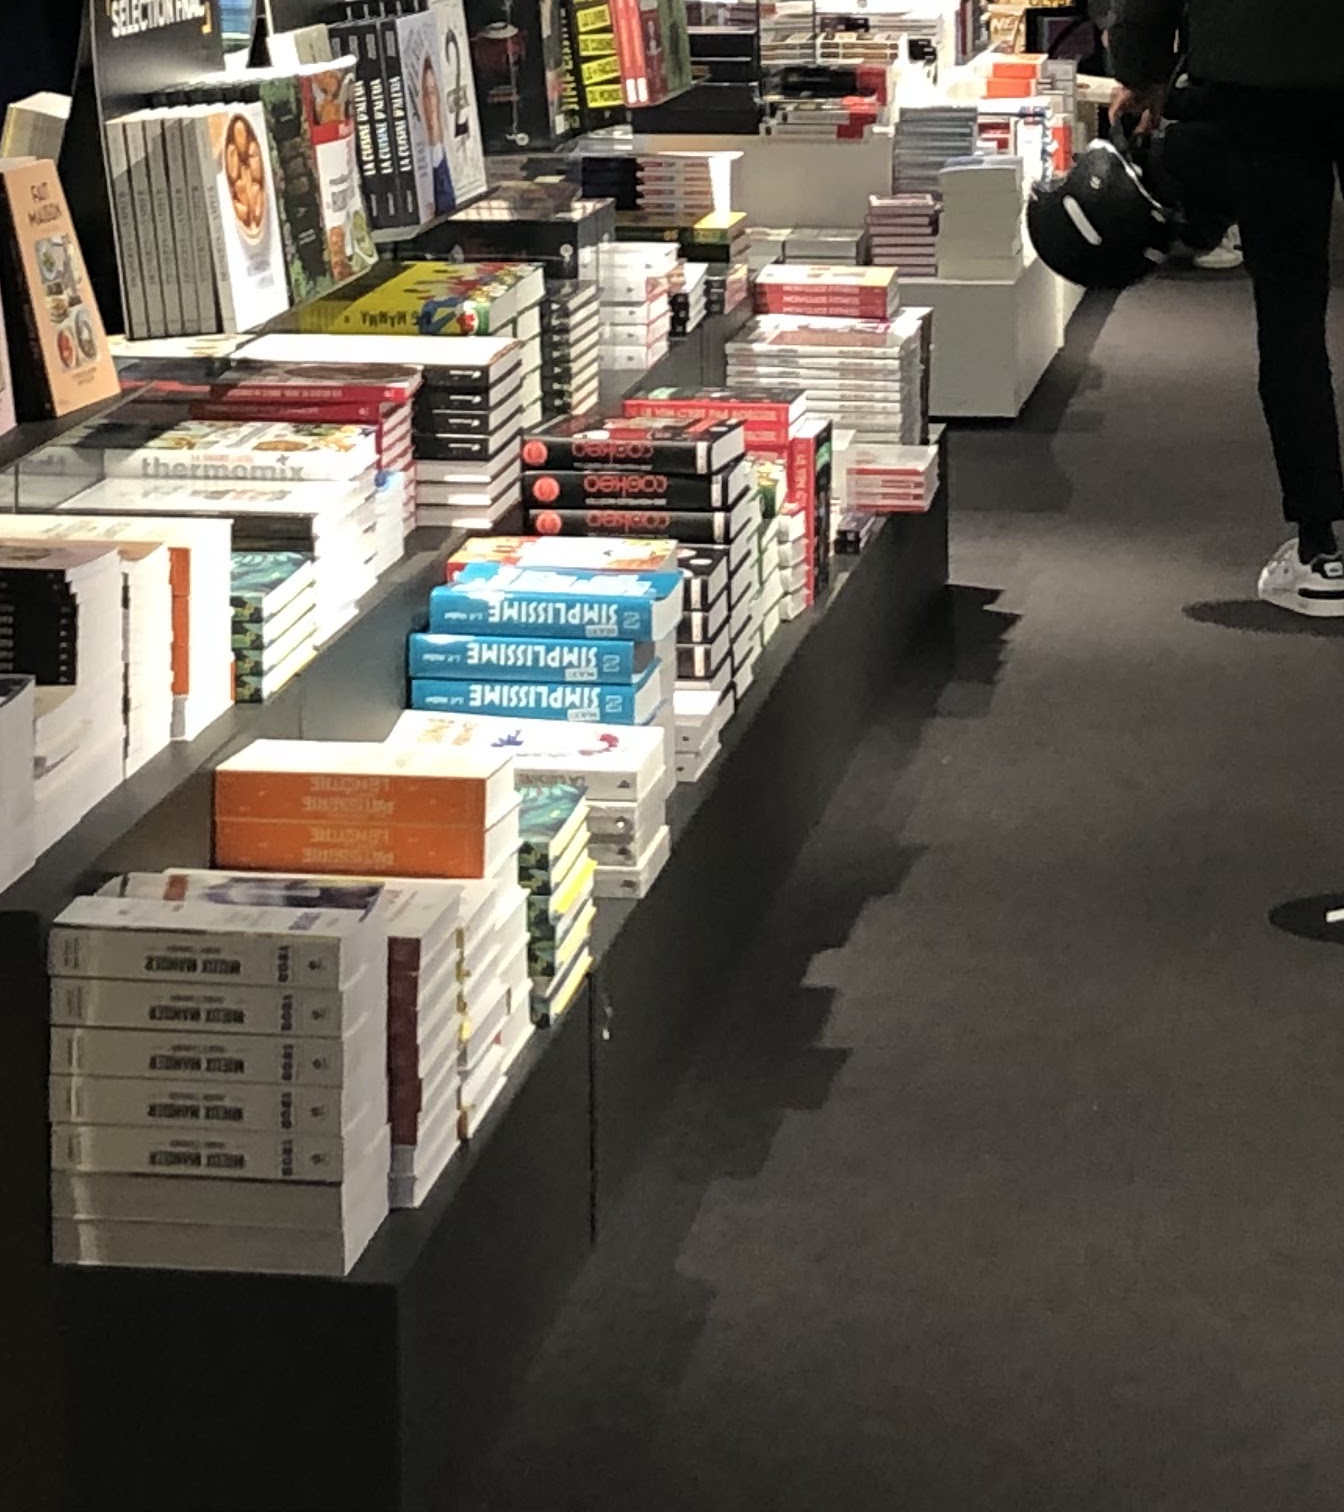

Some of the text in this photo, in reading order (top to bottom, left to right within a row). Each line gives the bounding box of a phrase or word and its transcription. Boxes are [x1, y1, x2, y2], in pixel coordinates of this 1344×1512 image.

[142, 454, 306, 481] thermomix
[487, 600, 618, 628] SIMPLISSIME
[466, 642, 599, 669] SIMPLISSIME
[468, 683, 602, 711] SIMPLISSIME
